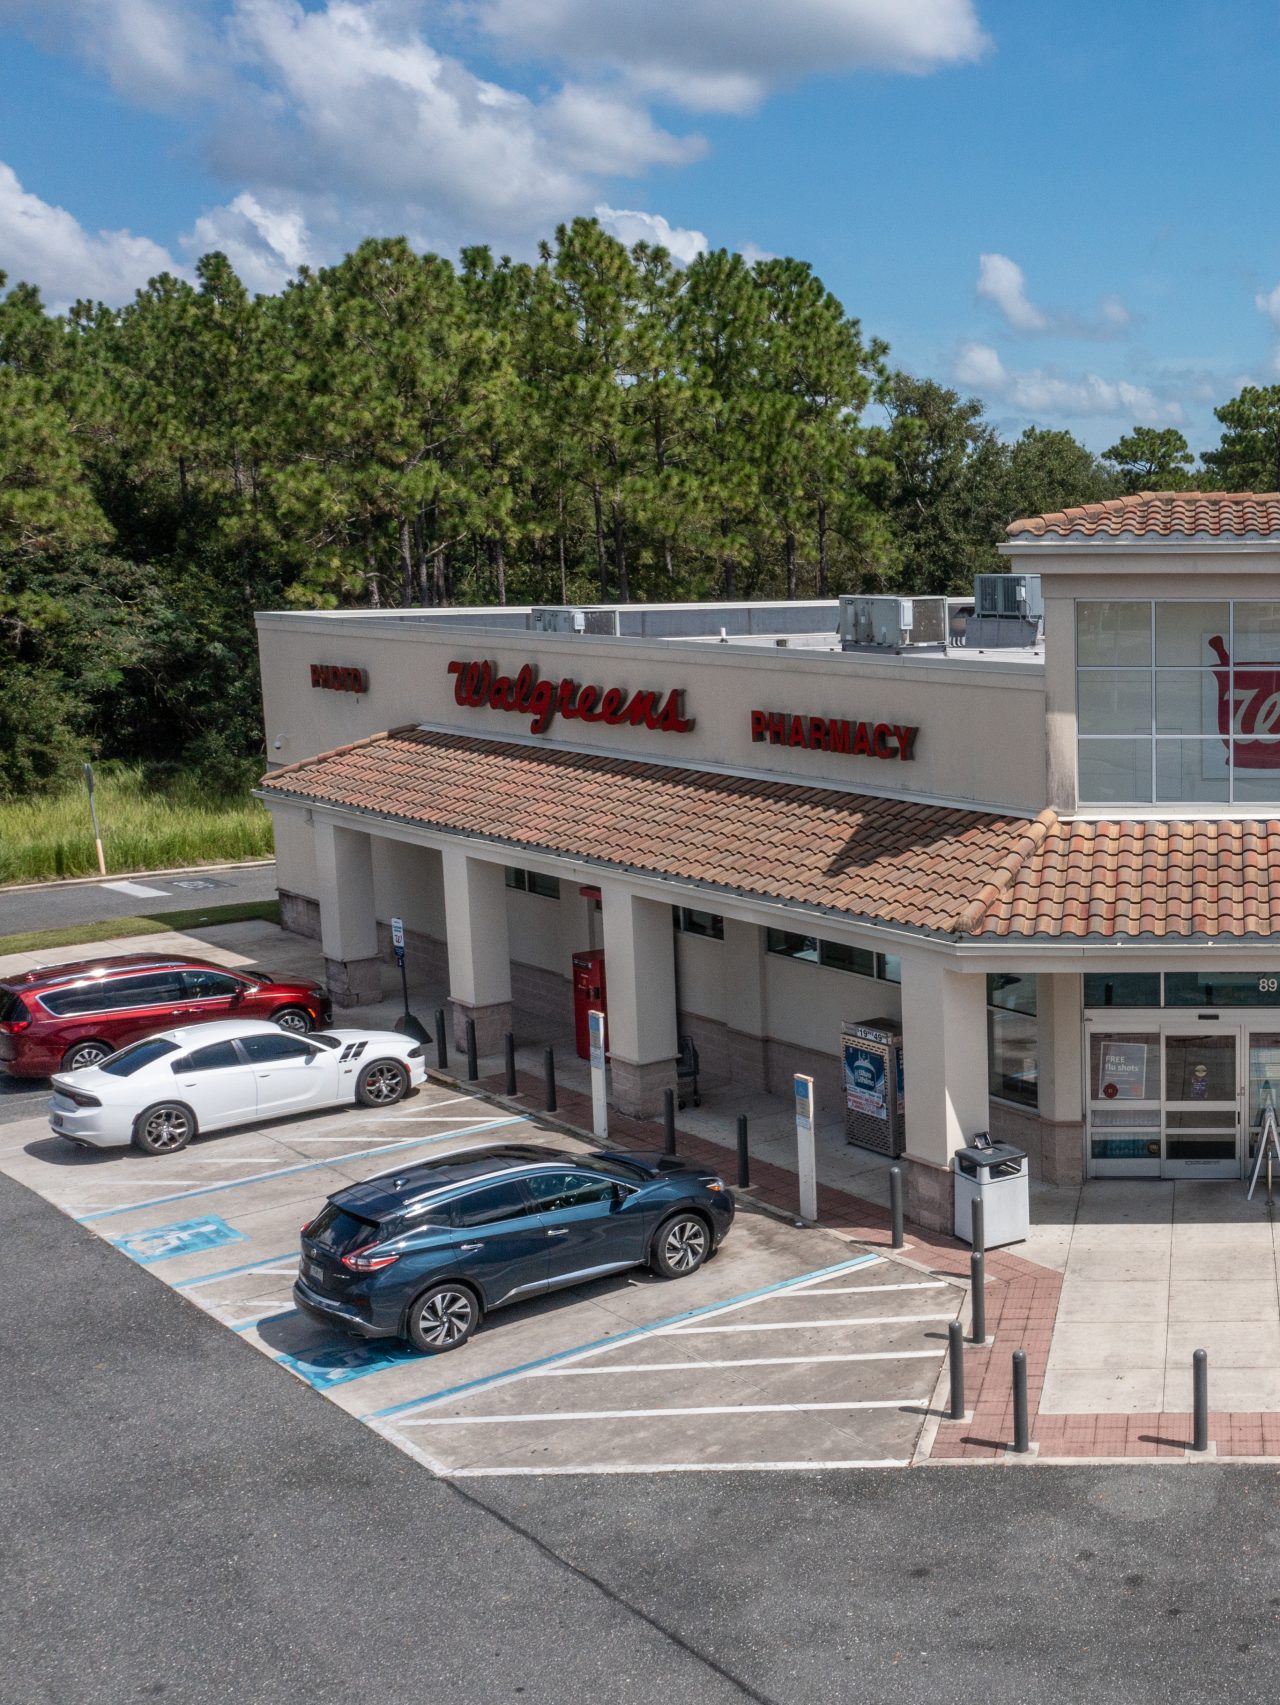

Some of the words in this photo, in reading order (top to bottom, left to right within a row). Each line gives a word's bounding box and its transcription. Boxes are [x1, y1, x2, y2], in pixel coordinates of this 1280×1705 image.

[448, 660, 694, 734] Walgreens
[751, 710, 918, 761] PHARMACY
[1259, 978, 1278, 992] 89
[1105, 1055, 1126, 1063] FREE
[1105, 1063, 1116, 1071] flu
[1117, 1064, 1139, 1072] shots
